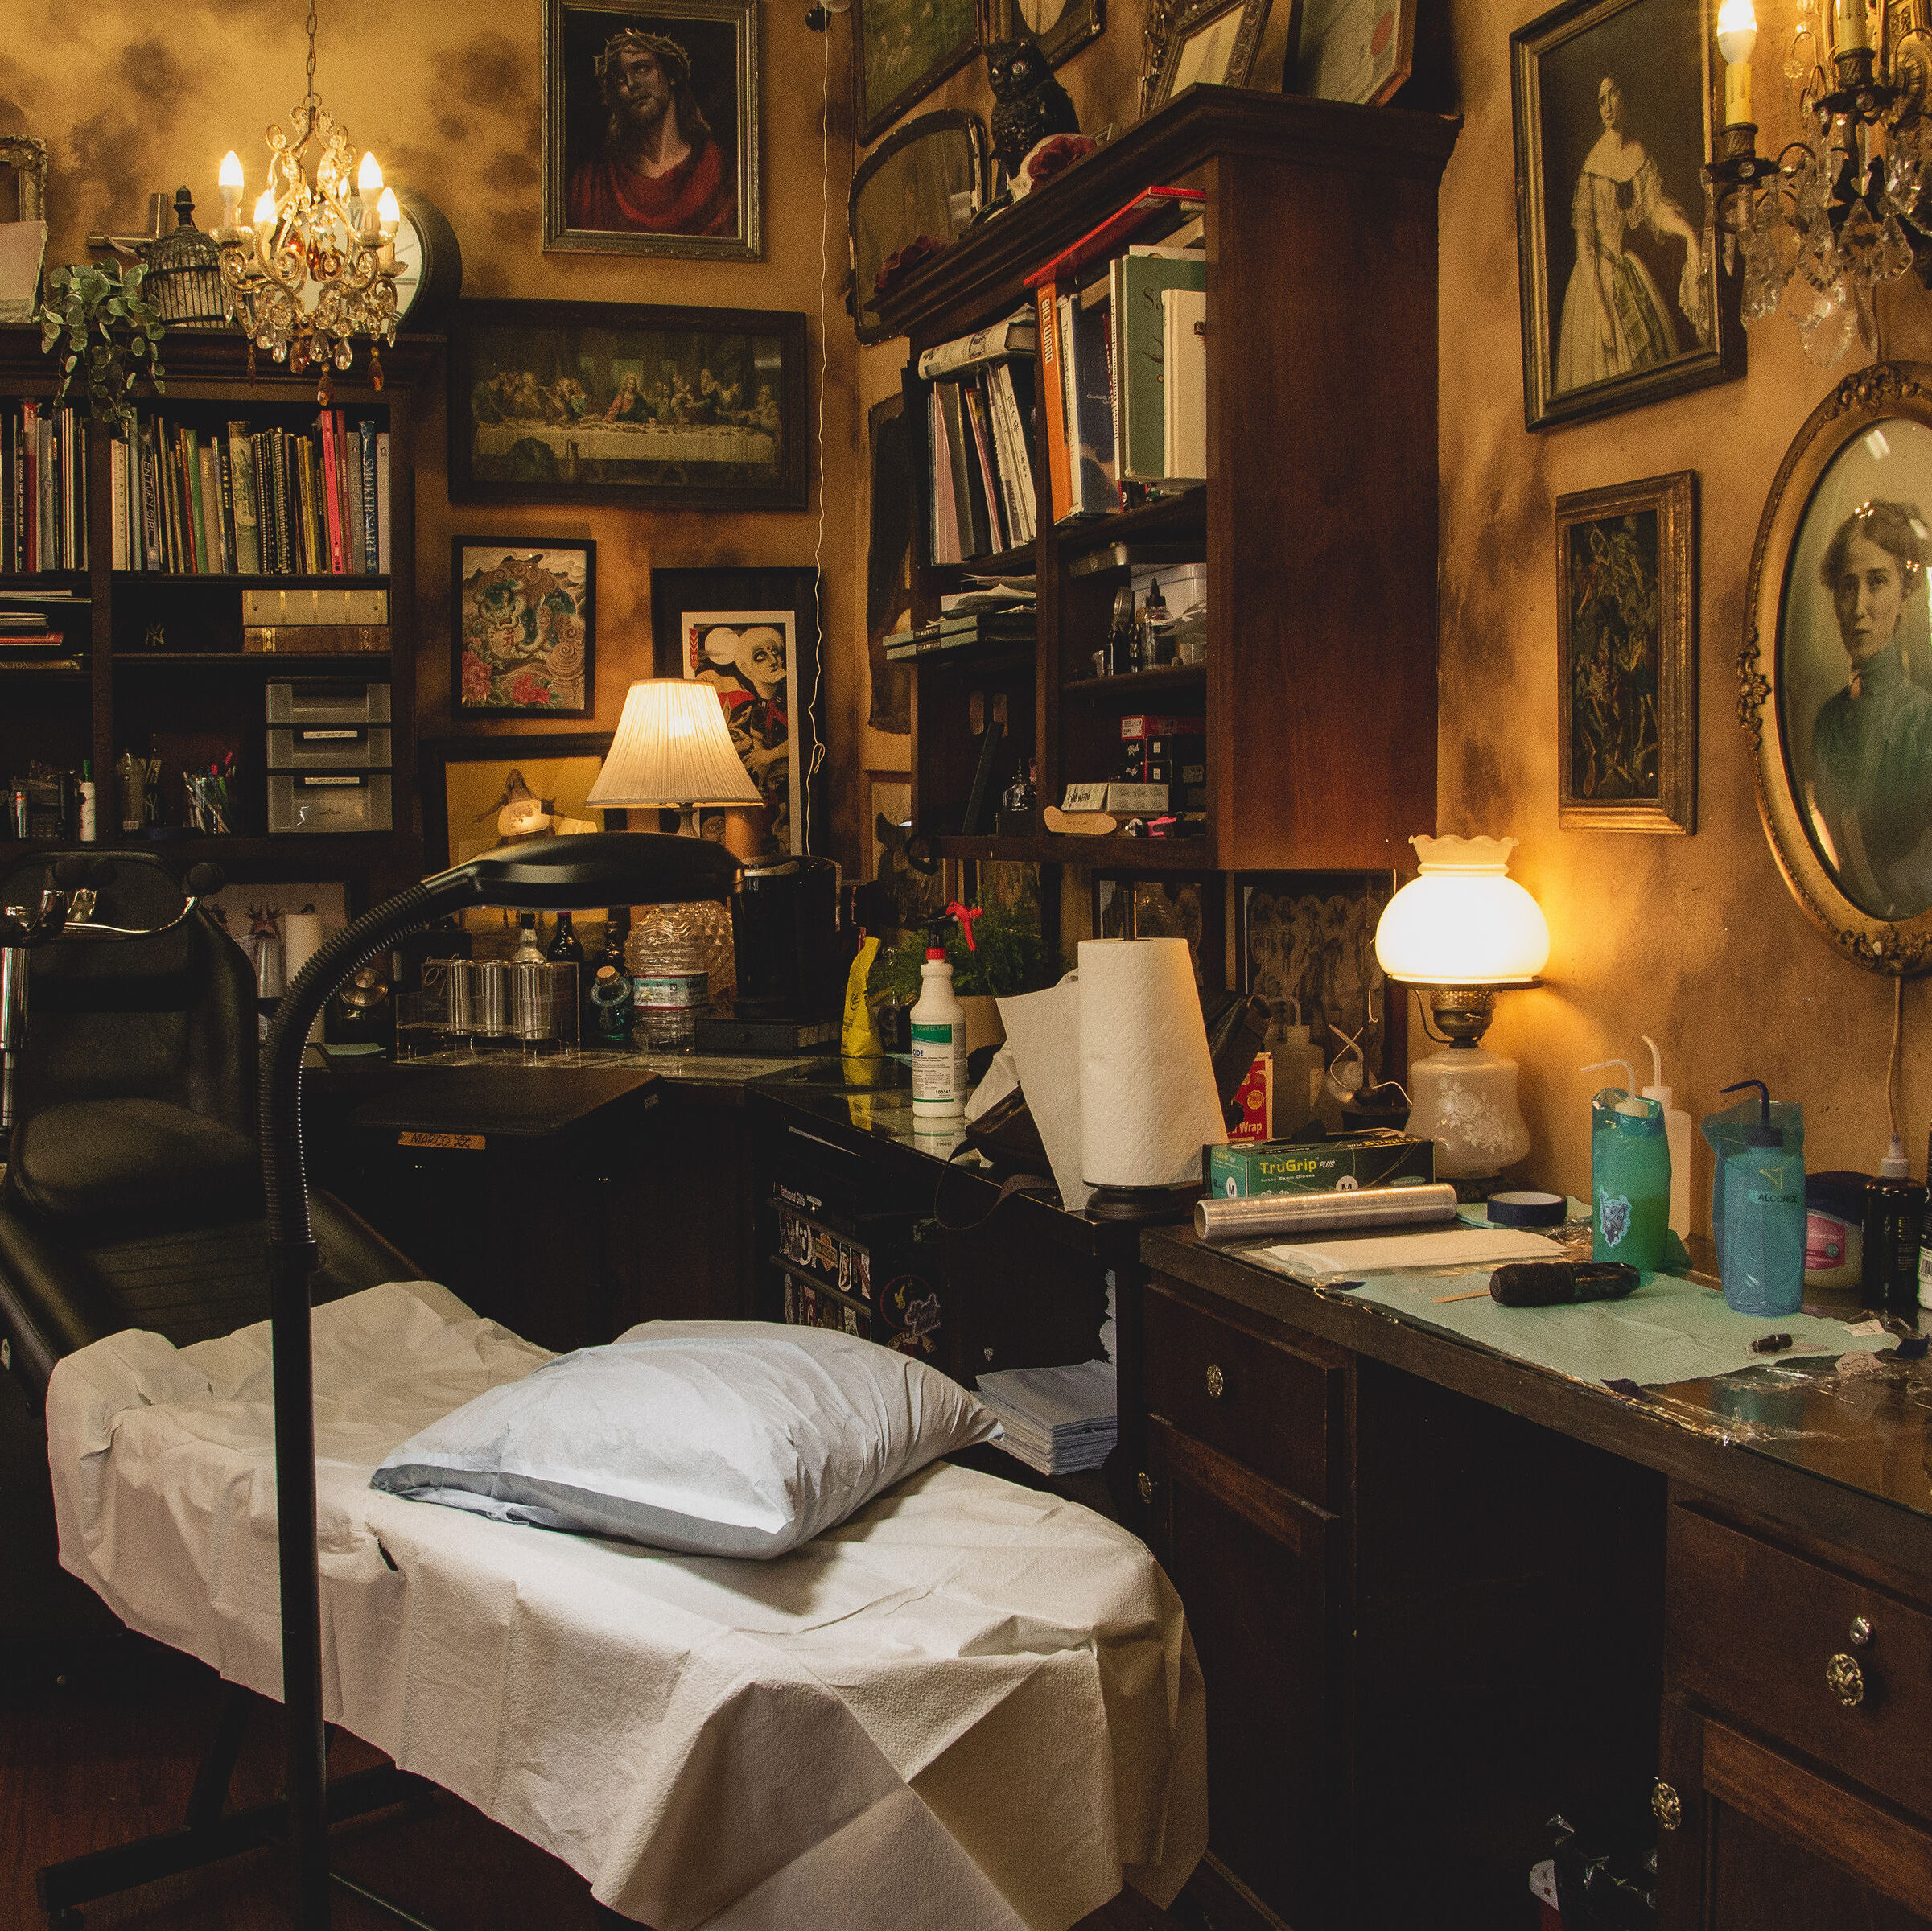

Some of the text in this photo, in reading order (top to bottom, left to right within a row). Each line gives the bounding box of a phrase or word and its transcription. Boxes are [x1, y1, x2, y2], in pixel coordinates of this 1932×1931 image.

[1040, 299, 1054, 364] BILL WARD
[1065, 375, 1073, 424] American
[143, 453, 155, 533] CENTURY GIRL
[1239, 1121, 1263, 1135] Wrap
[410, 1132, 451, 1147] MARCO
[1259, 1159, 1318, 1175] TruGrip
[1319, 1159, 1336, 1169] PLUS
[1229, 1184, 1234, 1194] M
[1341, 1182, 1353, 1190] M
[1757, 1193, 1798, 1204] ALCOHOL
